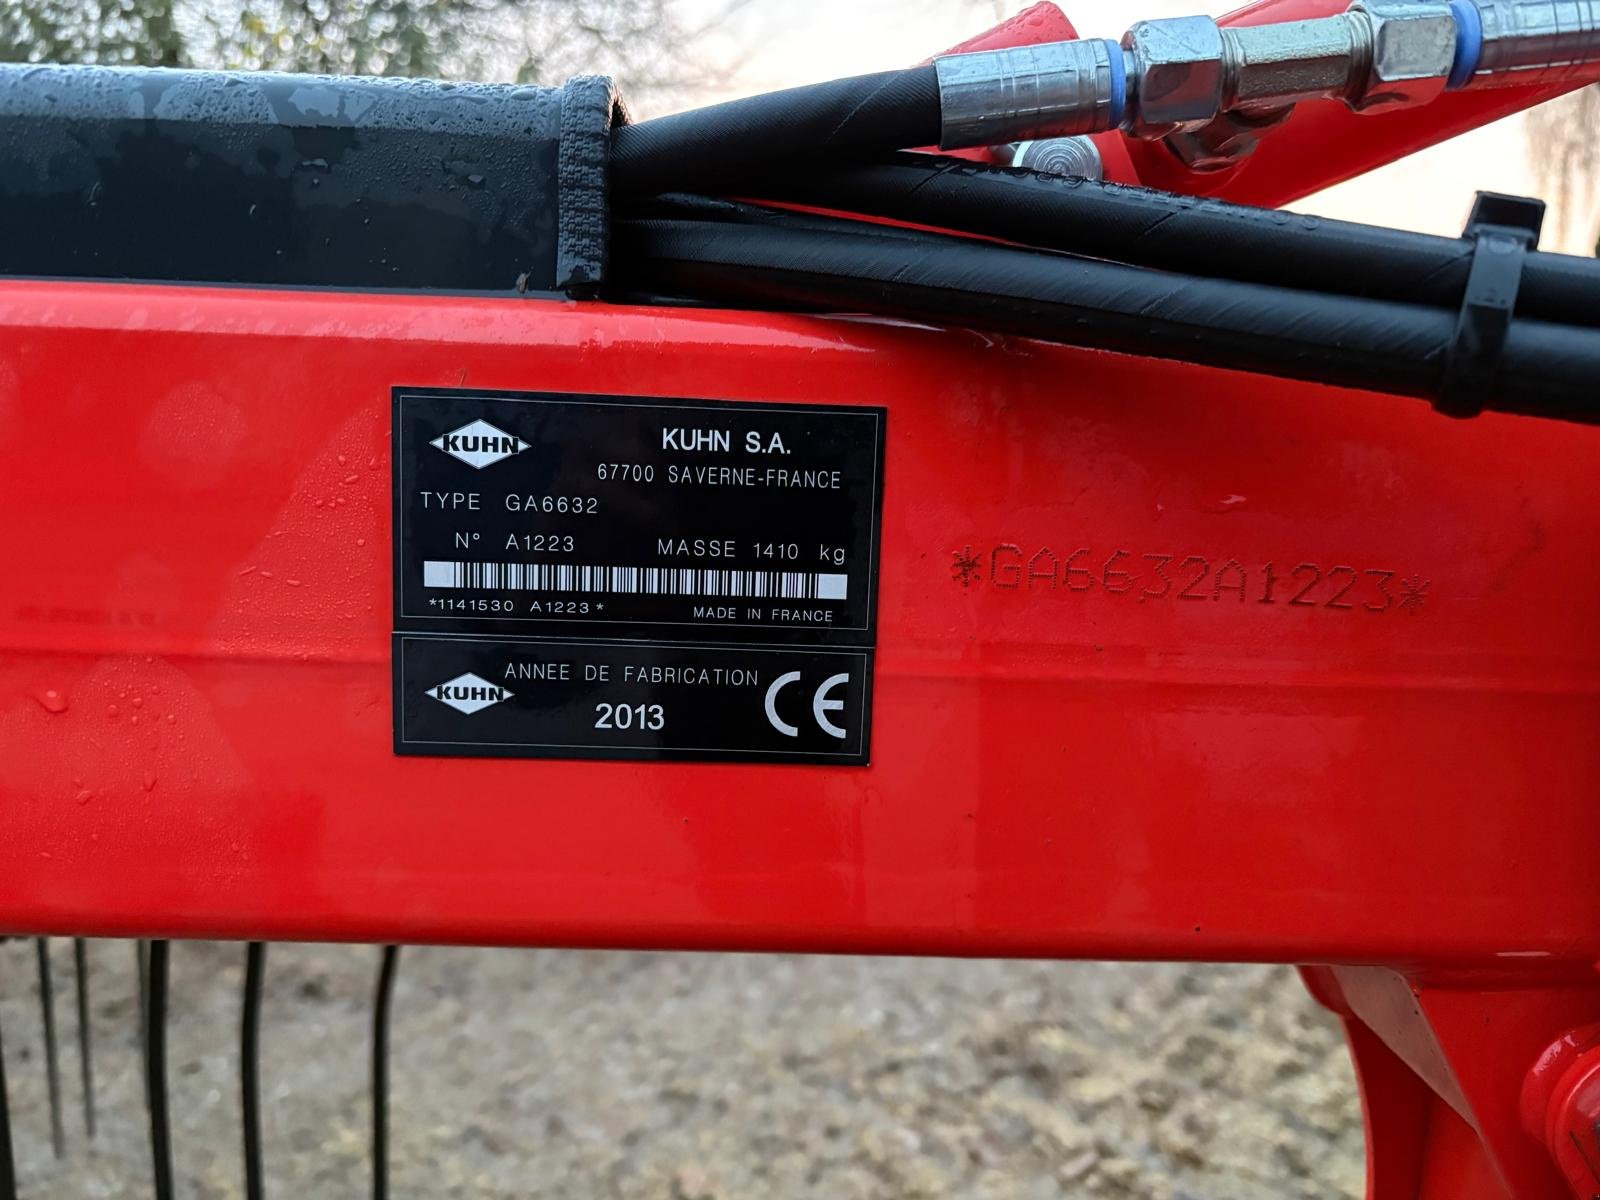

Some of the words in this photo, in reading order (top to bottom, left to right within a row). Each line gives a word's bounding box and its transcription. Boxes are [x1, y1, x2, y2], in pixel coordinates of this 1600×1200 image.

[443, 434, 519, 455] KUHN
[663, 428, 729, 451] KUHN
[746, 431, 790, 454] S.A.
[598, 464, 653, 482] 67700
[669, 466, 840, 488] SAVERNE-FRANCE
[421, 492, 480, 509] TYPE
[506, 494, 597, 513] GA6632
[506, 534, 573, 551] A1223
[659, 539, 735, 557] MASSE
[754, 544, 798, 559] 1410
[820, 544, 844, 565] kg
[694, 607, 735, 618] MADE
[748, 609, 760, 619] IN
[773, 609, 832, 621] FRANCE
[505, 663, 569, 679] ANNEE
[586, 665, 608, 681] DE
[625, 667, 757, 685] FABRICATION
[437, 685, 504, 701] KUHN
[595, 703, 664, 729] 2013
